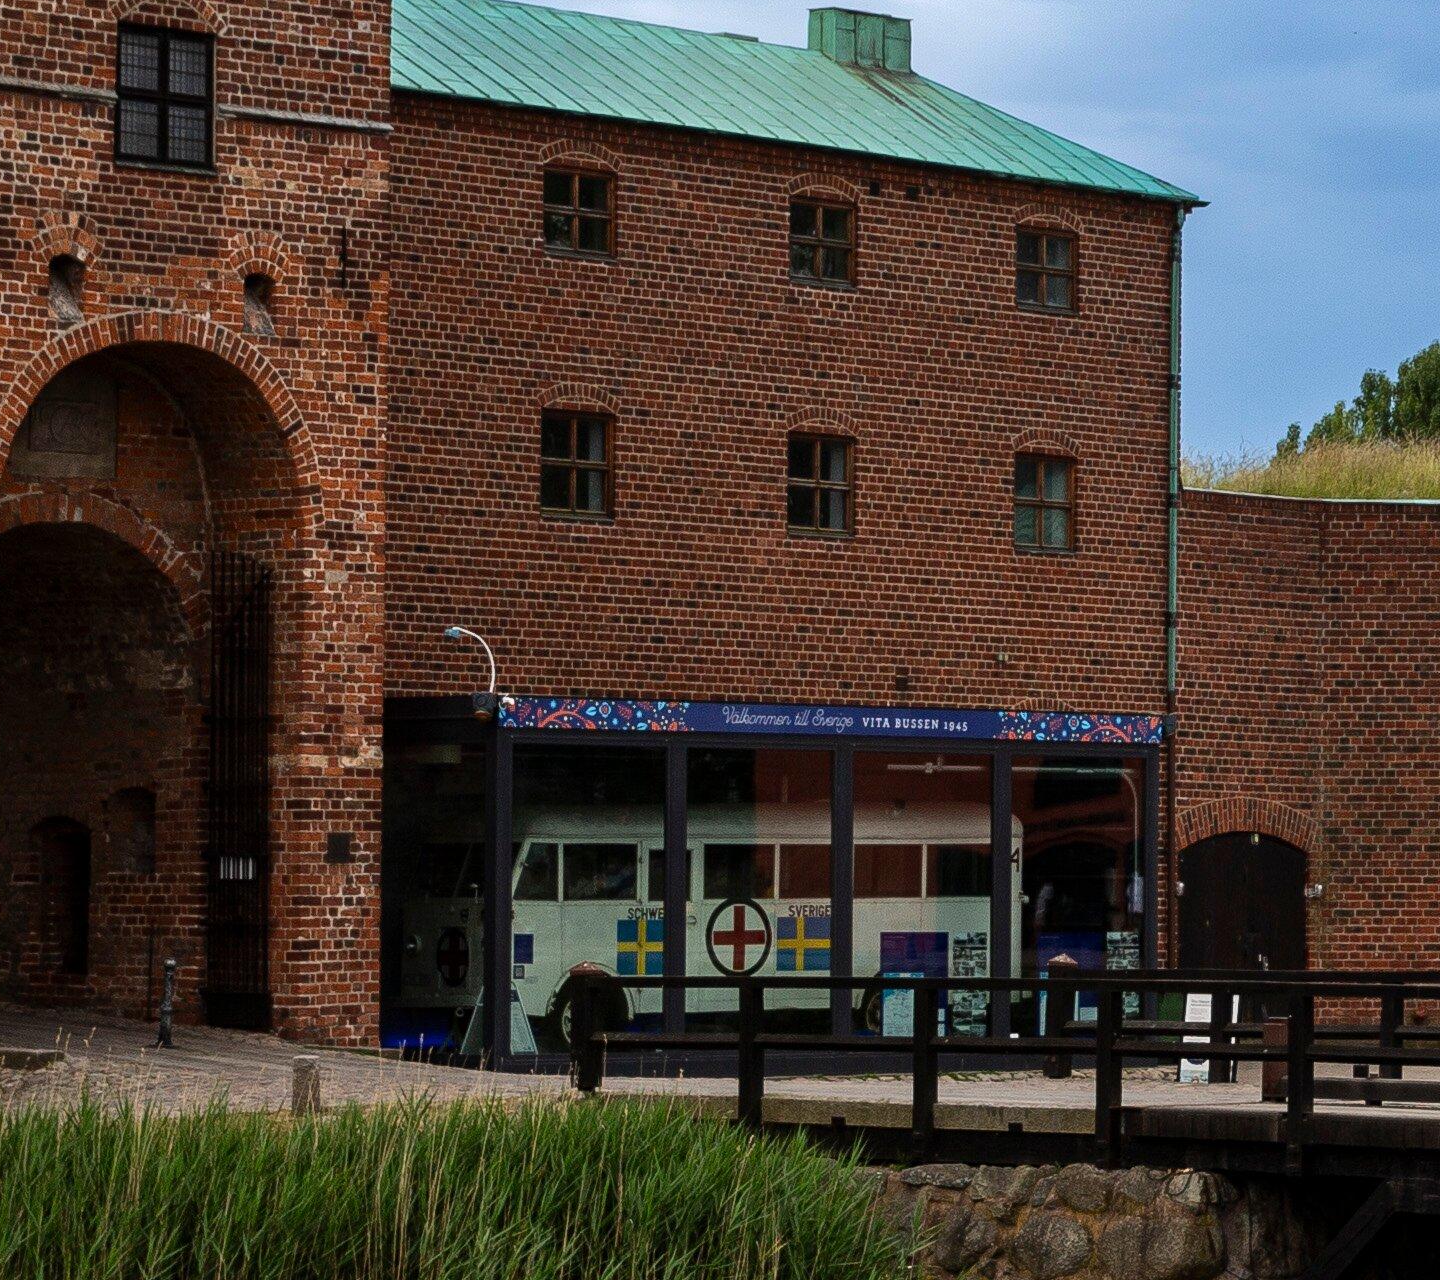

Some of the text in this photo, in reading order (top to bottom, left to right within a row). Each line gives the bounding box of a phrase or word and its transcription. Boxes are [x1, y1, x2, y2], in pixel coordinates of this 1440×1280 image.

[722, 706, 969, 733] Välkommen till Sverige VITA BUSSEN 1945
[788, 904, 831, 917] SVERIGE
